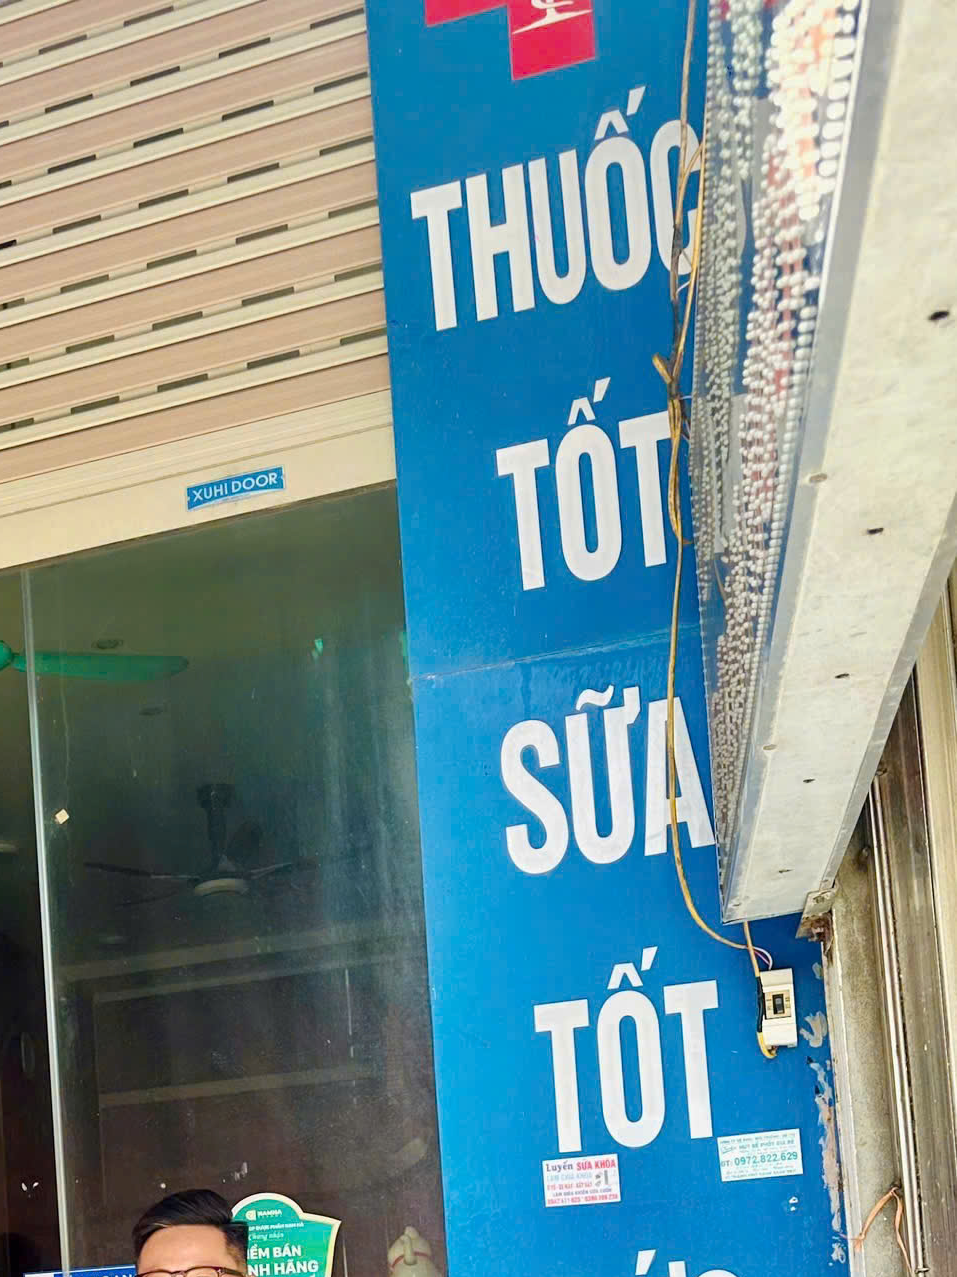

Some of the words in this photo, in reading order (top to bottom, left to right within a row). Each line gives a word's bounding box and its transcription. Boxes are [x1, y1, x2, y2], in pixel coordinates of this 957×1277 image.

[410, 86, 703, 331] THUỐC
[192, 483, 228, 502] XUHI
[231, 472, 278, 494] DOOR
[496, 377, 670, 591] TỐT
[500, 685, 716, 874] SỮA
[533, 946, 719, 1153] TỐT
[734, 1151, 798, 1166] 0972.822.629
[247, 1243, 270, 1260] IỂM
[272, 1243, 302, 1258] BÁN
[274, 1259, 319, 1276] HÃNG
